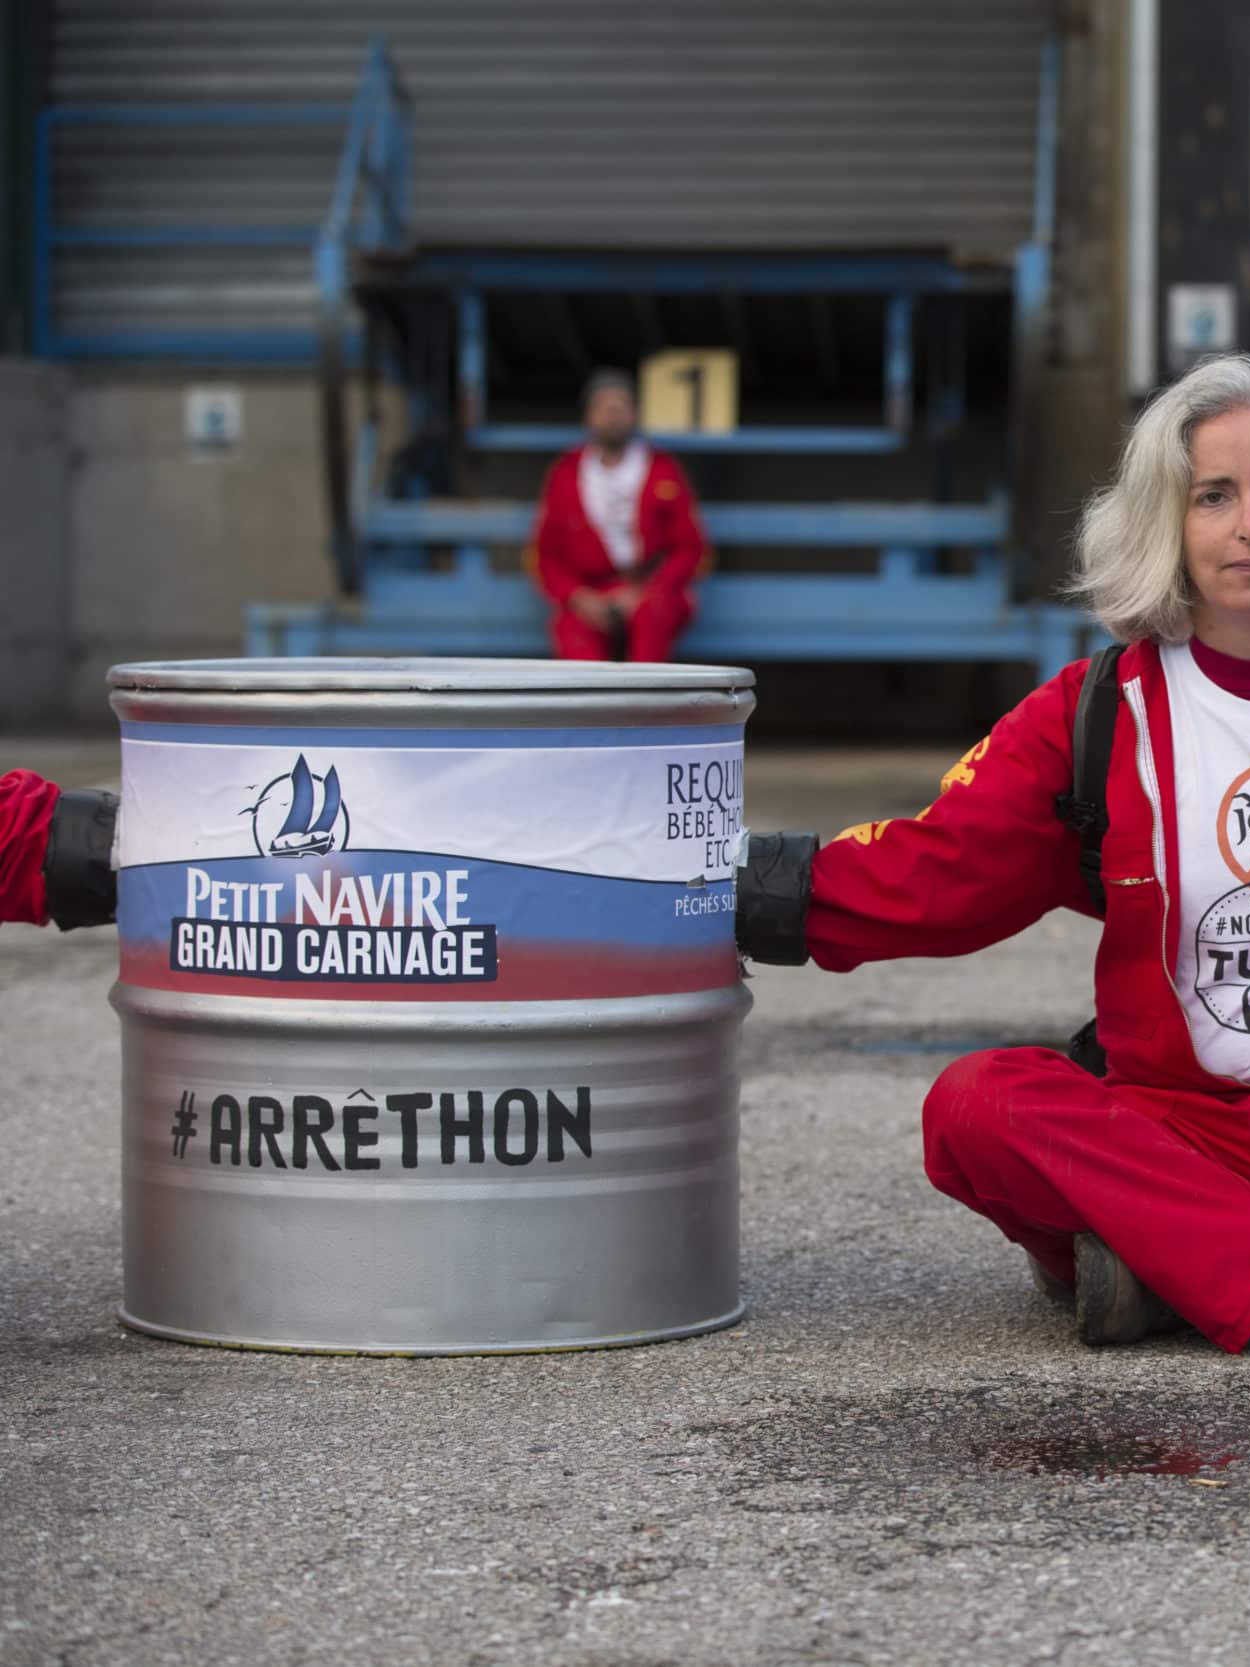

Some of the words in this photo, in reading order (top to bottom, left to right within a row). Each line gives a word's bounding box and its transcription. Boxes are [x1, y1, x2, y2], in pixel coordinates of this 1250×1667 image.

[673, 365, 705, 432] 1
[667, 804, 715, 840] BÉBÉ
[675, 892, 720, 917] PÊCHÉS
[721, 893, 735, 911] SU
[178, 921, 283, 973] GRAND
[296, 929, 486, 977] CARNAGE
[171, 1086, 593, 1171] #ARRÊTHON
